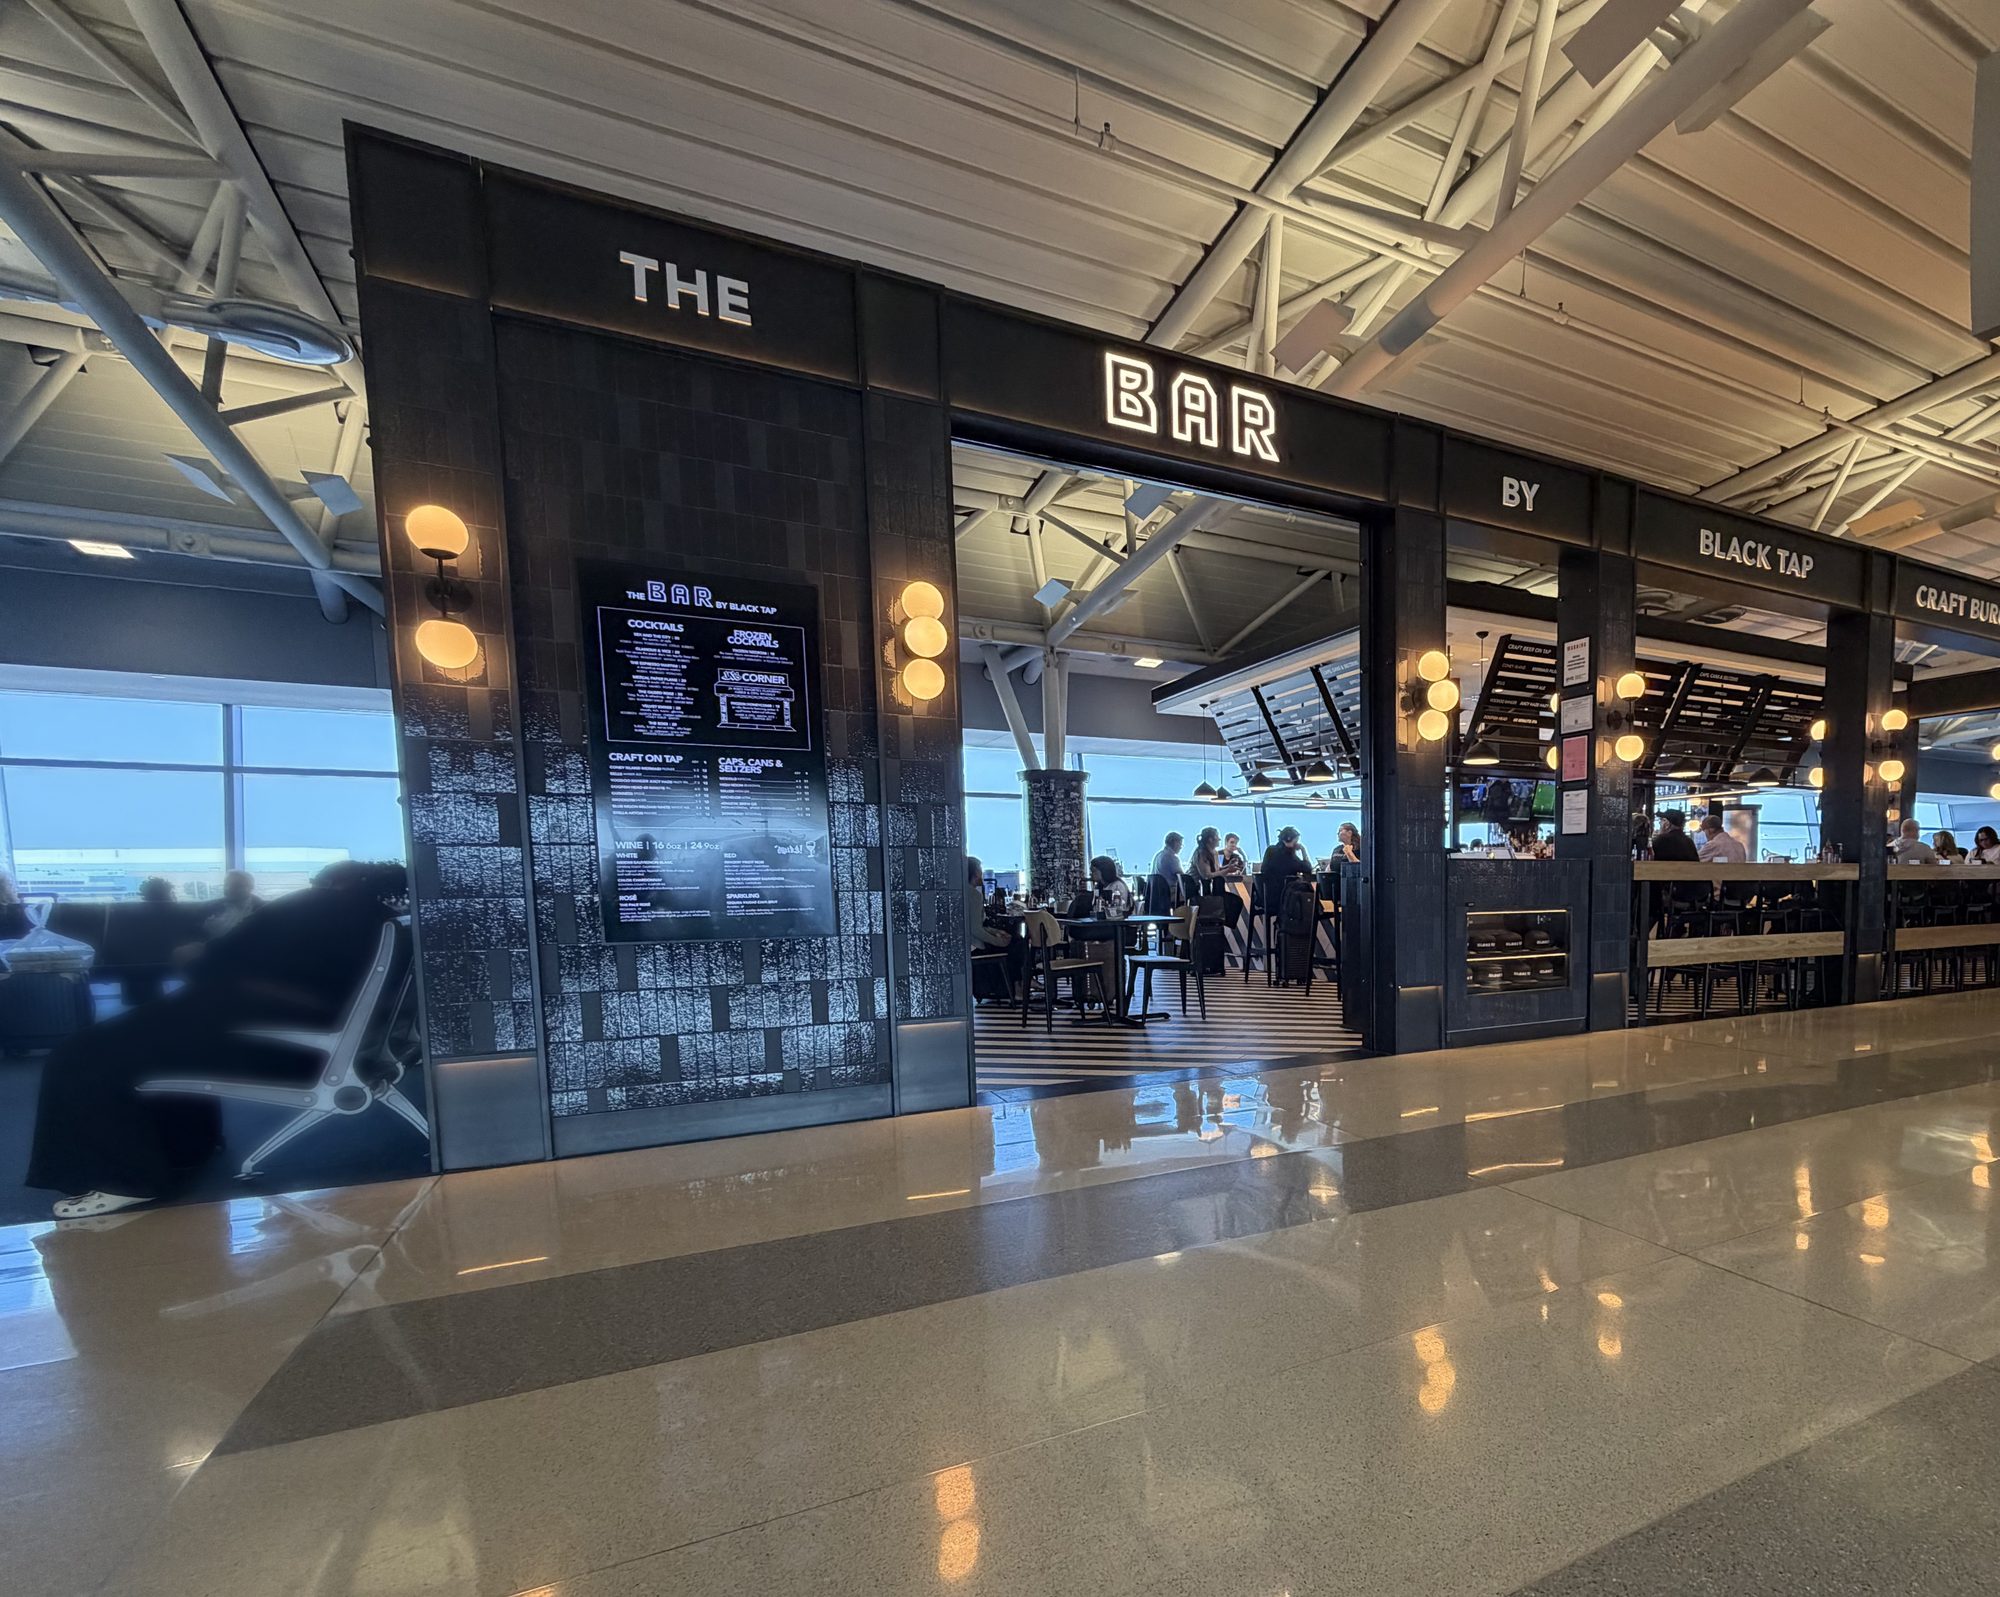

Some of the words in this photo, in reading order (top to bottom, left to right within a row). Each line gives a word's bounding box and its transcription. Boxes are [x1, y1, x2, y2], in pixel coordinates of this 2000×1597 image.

[619, 250, 752, 326] THE
[1105, 352, 1280, 463] BAR
[1503, 476, 1540, 511] BY
[1700, 528, 1772, 570] BLACK
[1777, 548, 1814, 578] TAP
[626, 591, 646, 600] THE
[647, 580, 713, 608] BAR
[715, 601, 728, 609] BY
[729, 602, 759, 613] BLACK
[760, 606, 777, 614] TAP
[1916, 585, 1967, 616] CRAFT
[1970, 598, 2000, 625] BUR
[627, 619, 684, 632] COCKTAILS
[733, 629, 772, 641] FROZEN
[727, 636, 779, 648] COCKTAILS
[742, 673, 785, 684] CORNER
[608, 752, 643, 762] CRAFT
[644, 754, 662, 763] ON
[663, 755, 683, 764] TAP
[718, 757, 746, 766] CAPS,
[747, 758, 773, 767] CANS
[775, 760, 783, 768] &
[719, 765, 762, 774] SELTZERS
[615, 841, 644, 850] WINE
[652, 841, 664, 849] 16
[690, 841, 702, 849] 24
[703, 842, 719, 850] 9oz
